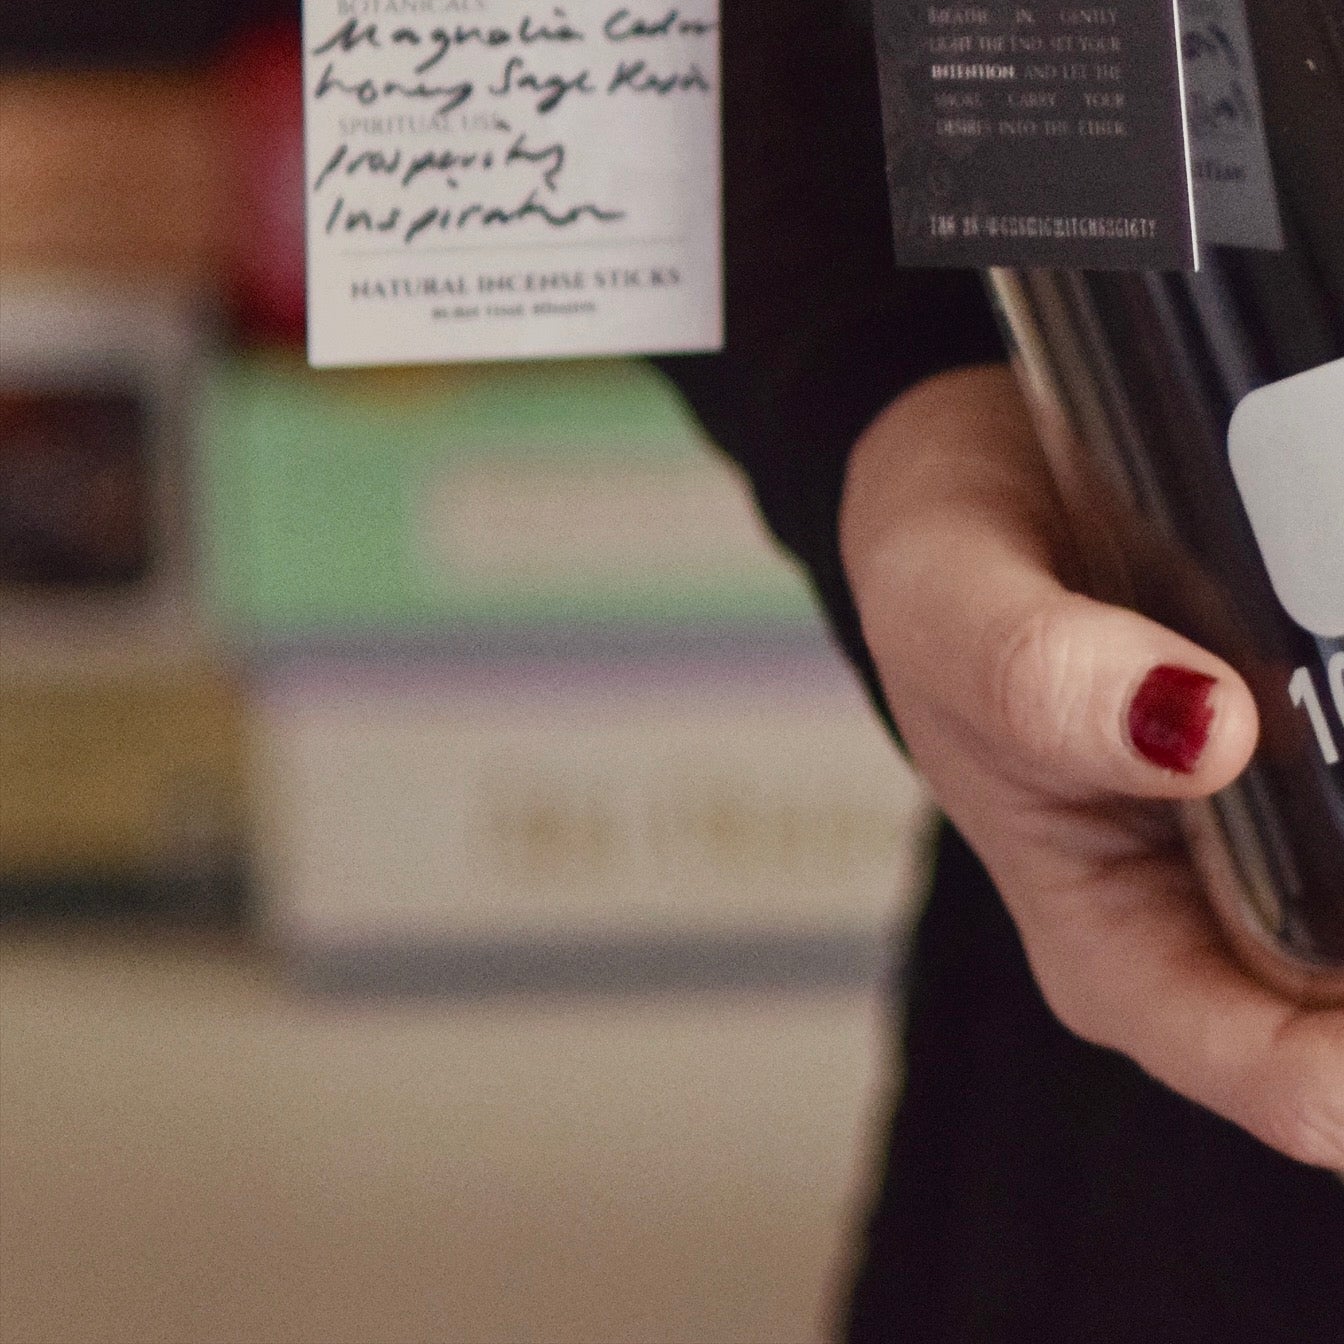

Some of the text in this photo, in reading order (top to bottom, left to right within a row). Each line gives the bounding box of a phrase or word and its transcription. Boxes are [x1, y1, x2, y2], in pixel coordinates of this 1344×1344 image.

[351, 266, 681, 301] NATURAL INCENSE STICKS
